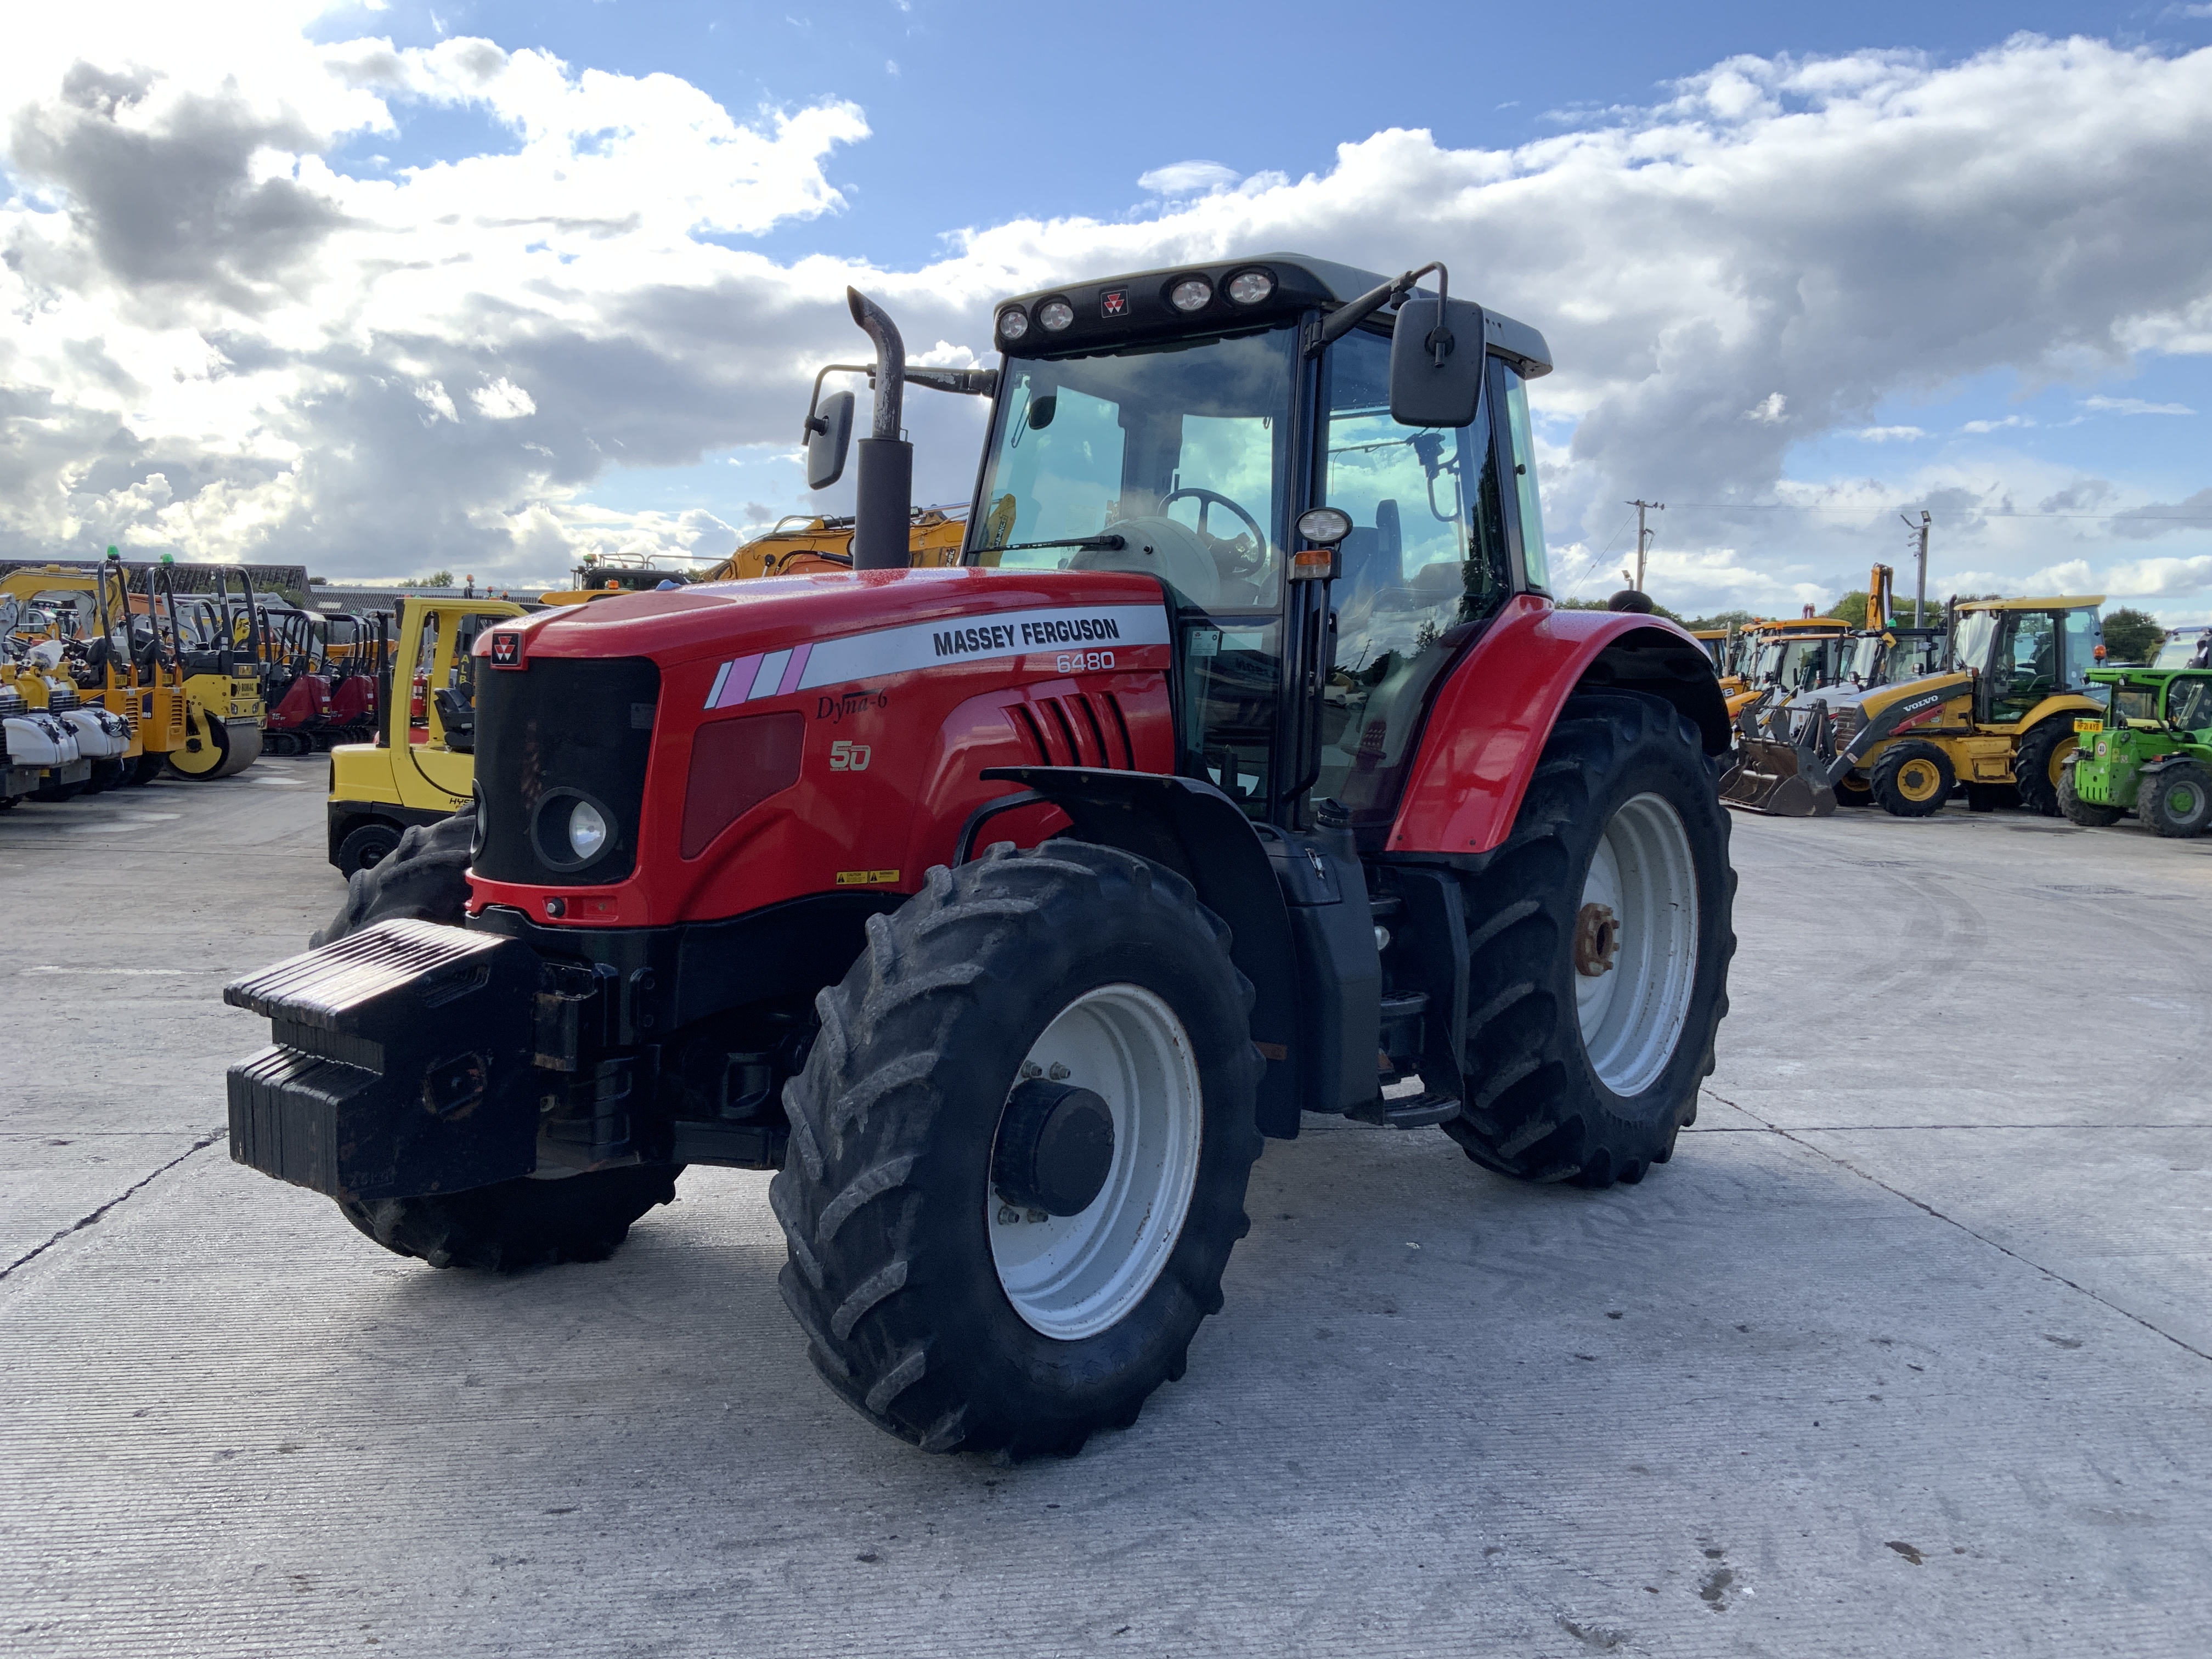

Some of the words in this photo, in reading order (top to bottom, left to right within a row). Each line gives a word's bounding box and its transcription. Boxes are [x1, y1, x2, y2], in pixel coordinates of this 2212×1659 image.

[933, 624, 1015, 656] MASSEY
[1022, 619, 1120, 646] FERGUSON
[1057, 651, 1115, 674] 6480
[816, 687, 888, 724] Dyna-6
[1903, 695, 1938, 712] VOLVO
[830, 741, 871, 771] 50
[449, 797, 474, 806] HYS
